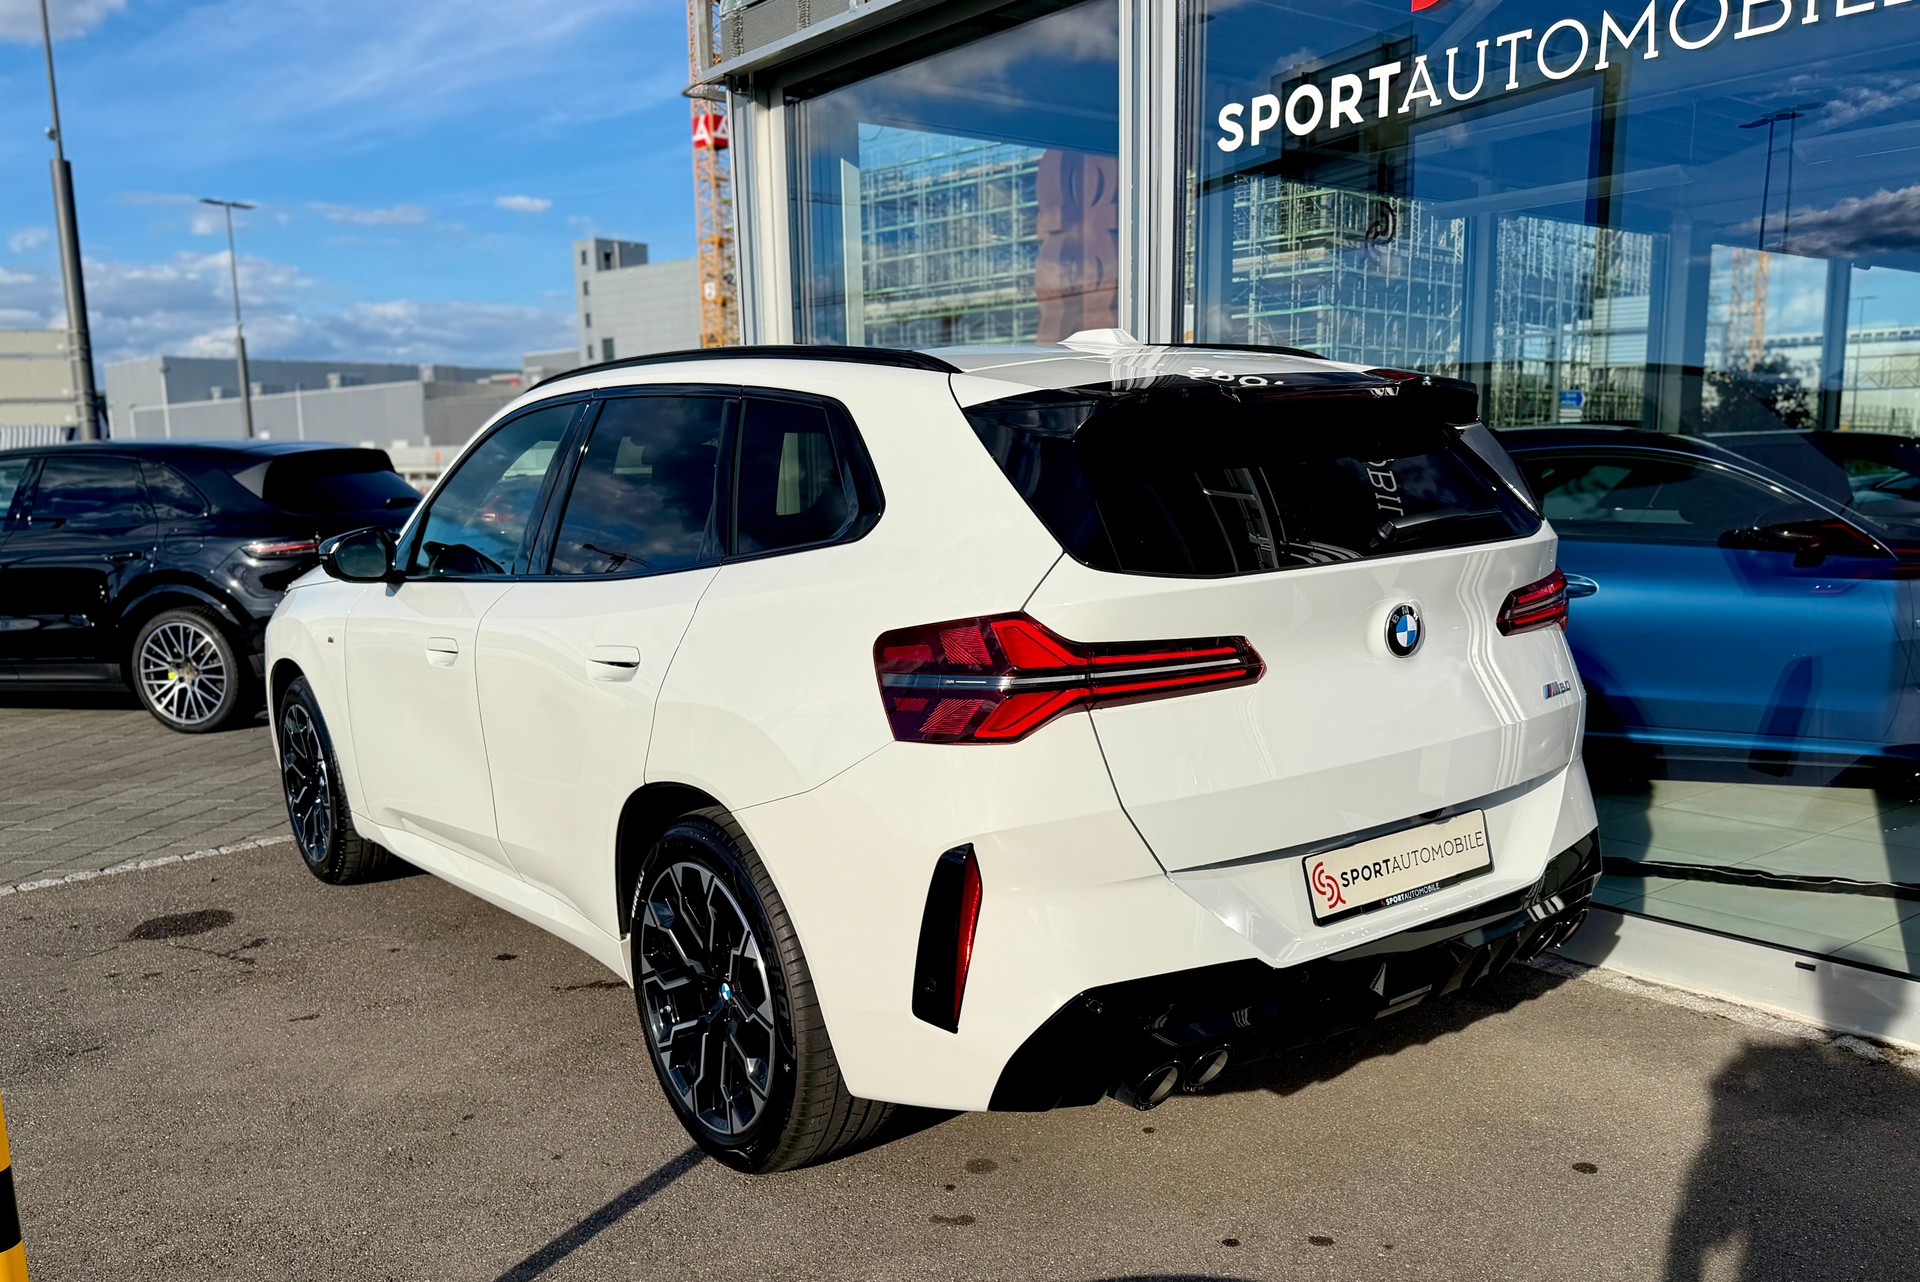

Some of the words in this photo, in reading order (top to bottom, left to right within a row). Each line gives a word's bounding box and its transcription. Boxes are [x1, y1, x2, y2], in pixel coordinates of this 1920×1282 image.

[1217, 0, 1920, 152] SPORTAUTOMOB
[1340, 831, 1484, 888] SPORTAUTOMOBILE
[1385, 882, 1440, 906] SPORTAUTOMOBILE
